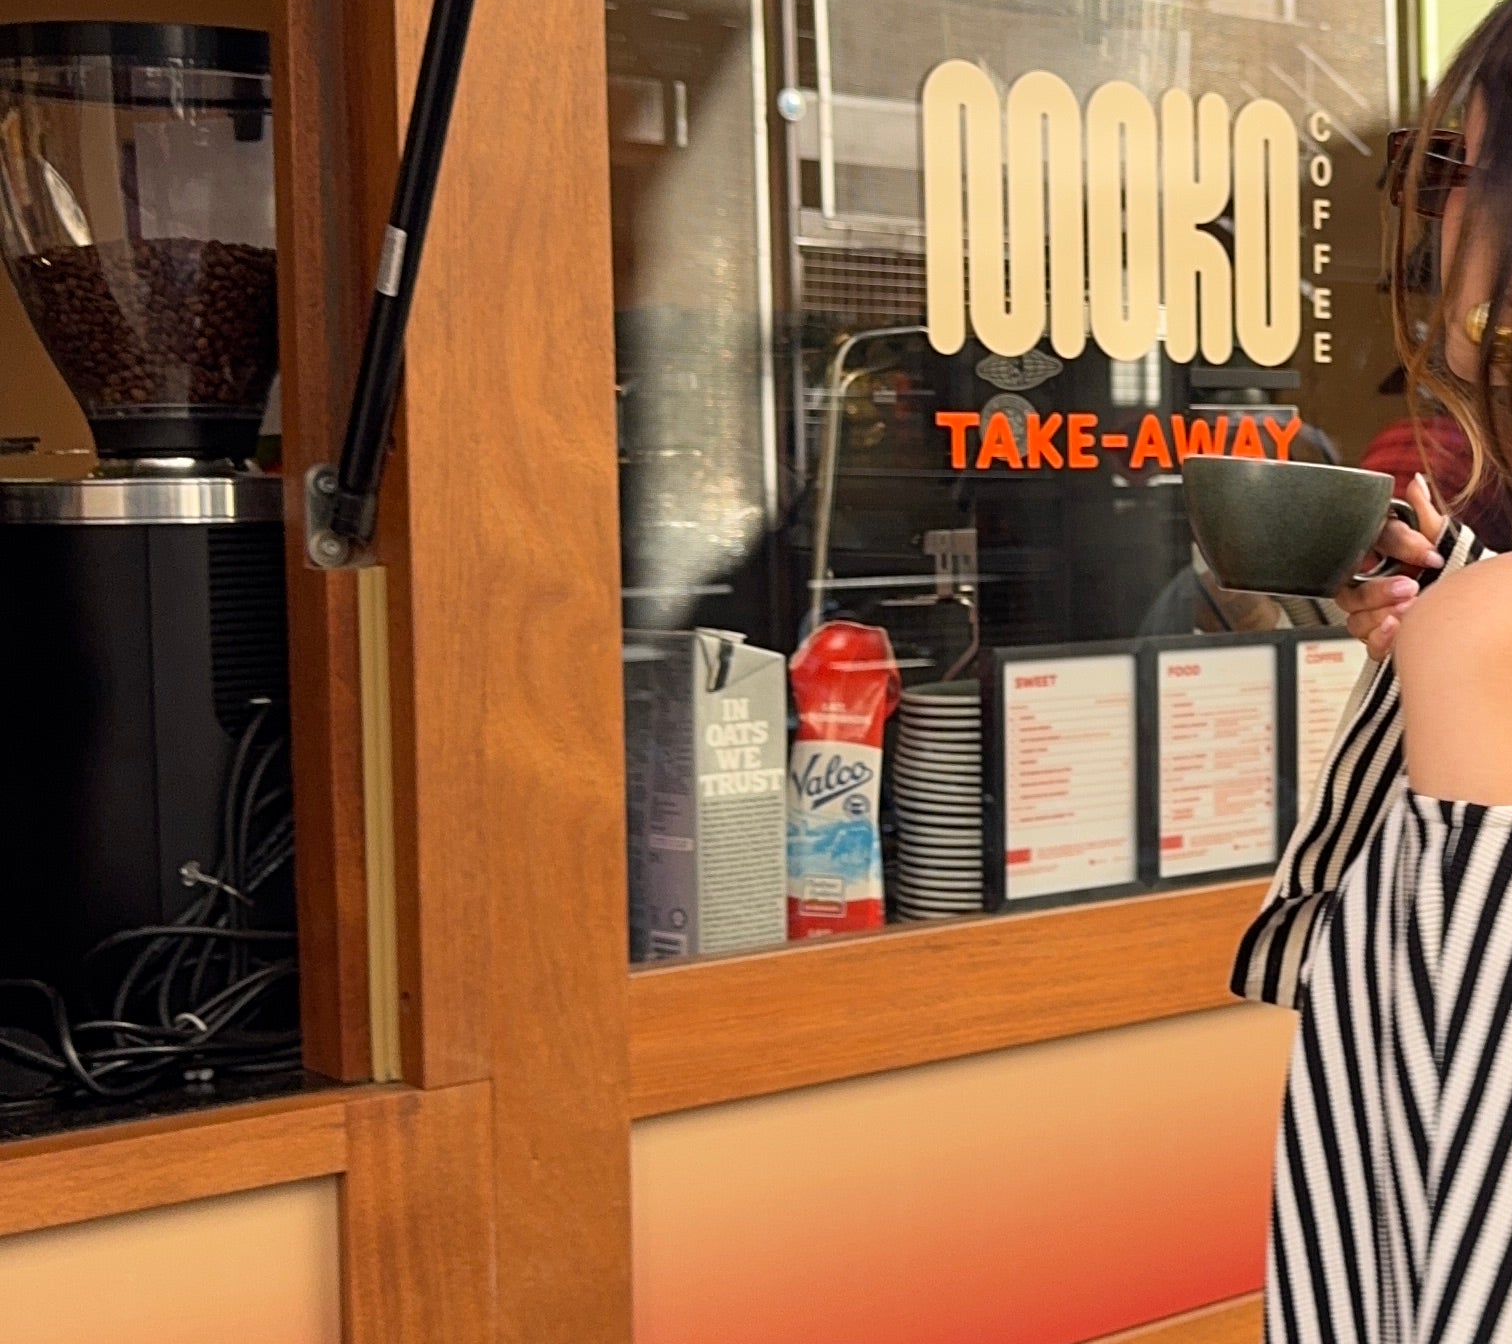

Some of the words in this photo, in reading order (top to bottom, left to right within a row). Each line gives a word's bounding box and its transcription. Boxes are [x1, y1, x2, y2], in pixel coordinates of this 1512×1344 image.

[923, 59, 1301, 367] MOKO
[1308, 110, 1333, 363] COFFEE
[936, 411, 1302, 470] TAKE-AWAY
[1014, 674, 1057, 689] SWEET
[1167, 664, 1201, 677] FOOD
[721, 698, 749, 721] IN
[706, 721, 769, 746] OATS
[717, 746, 761, 770] WE
[700, 772, 783, 797] TRUST
[790, 753, 873, 804] Valco
